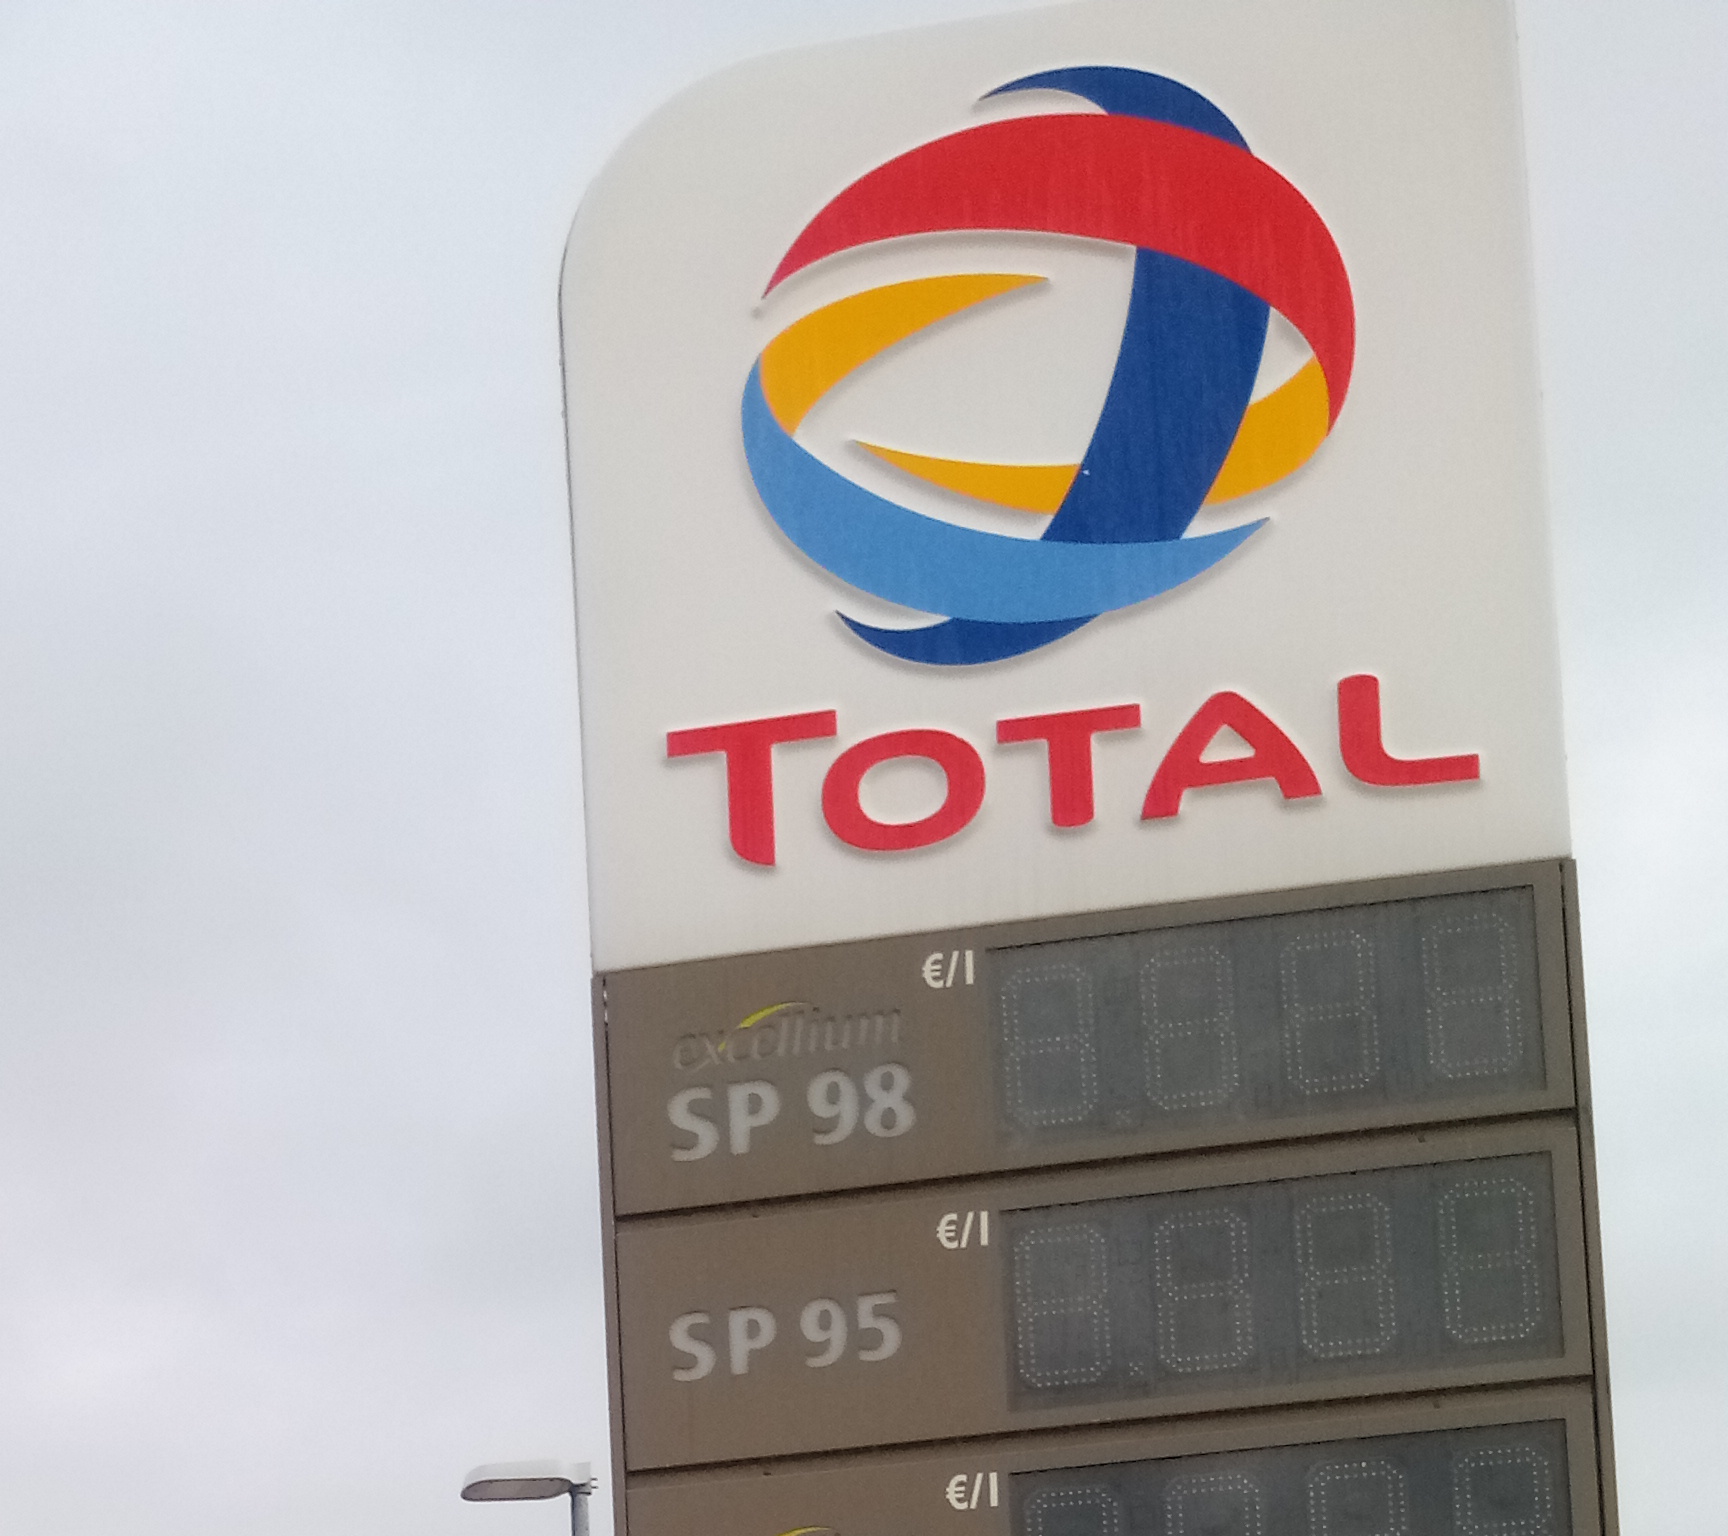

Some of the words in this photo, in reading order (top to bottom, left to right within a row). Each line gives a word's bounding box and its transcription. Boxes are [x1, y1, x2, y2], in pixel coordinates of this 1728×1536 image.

[666, 674, 1480, 867] TOTAL
[667, 1080, 780, 1162] SP
[807, 1062, 918, 1146] 98
[668, 1305, 777, 1382] SP
[799, 1290, 903, 1369] 95
